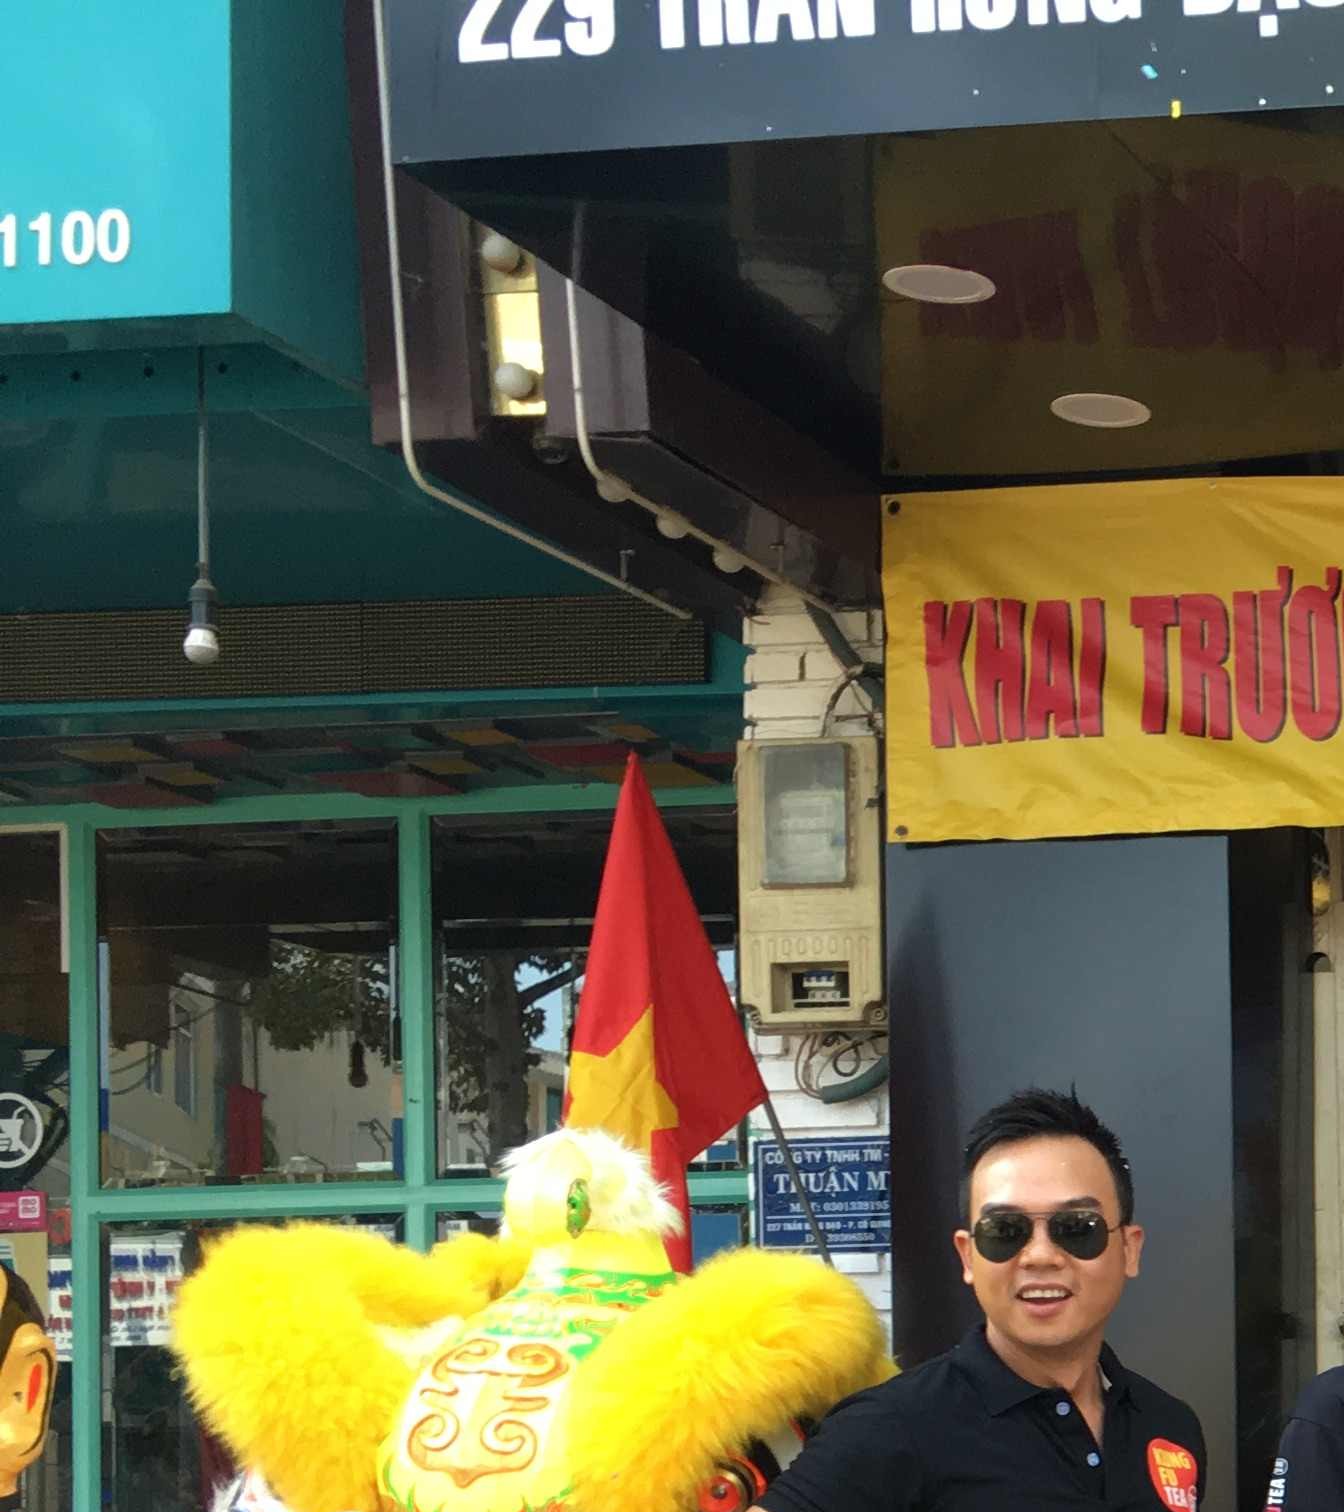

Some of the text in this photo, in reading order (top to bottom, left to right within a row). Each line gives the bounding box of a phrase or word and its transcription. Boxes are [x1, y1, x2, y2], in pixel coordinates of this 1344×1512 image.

[0, 208, 131, 267] 1100
[922, 596, 1107, 749] KHAI
[765, 1149, 802, 1164] CÔG
[1267, 1477, 1287, 1505] TEA
